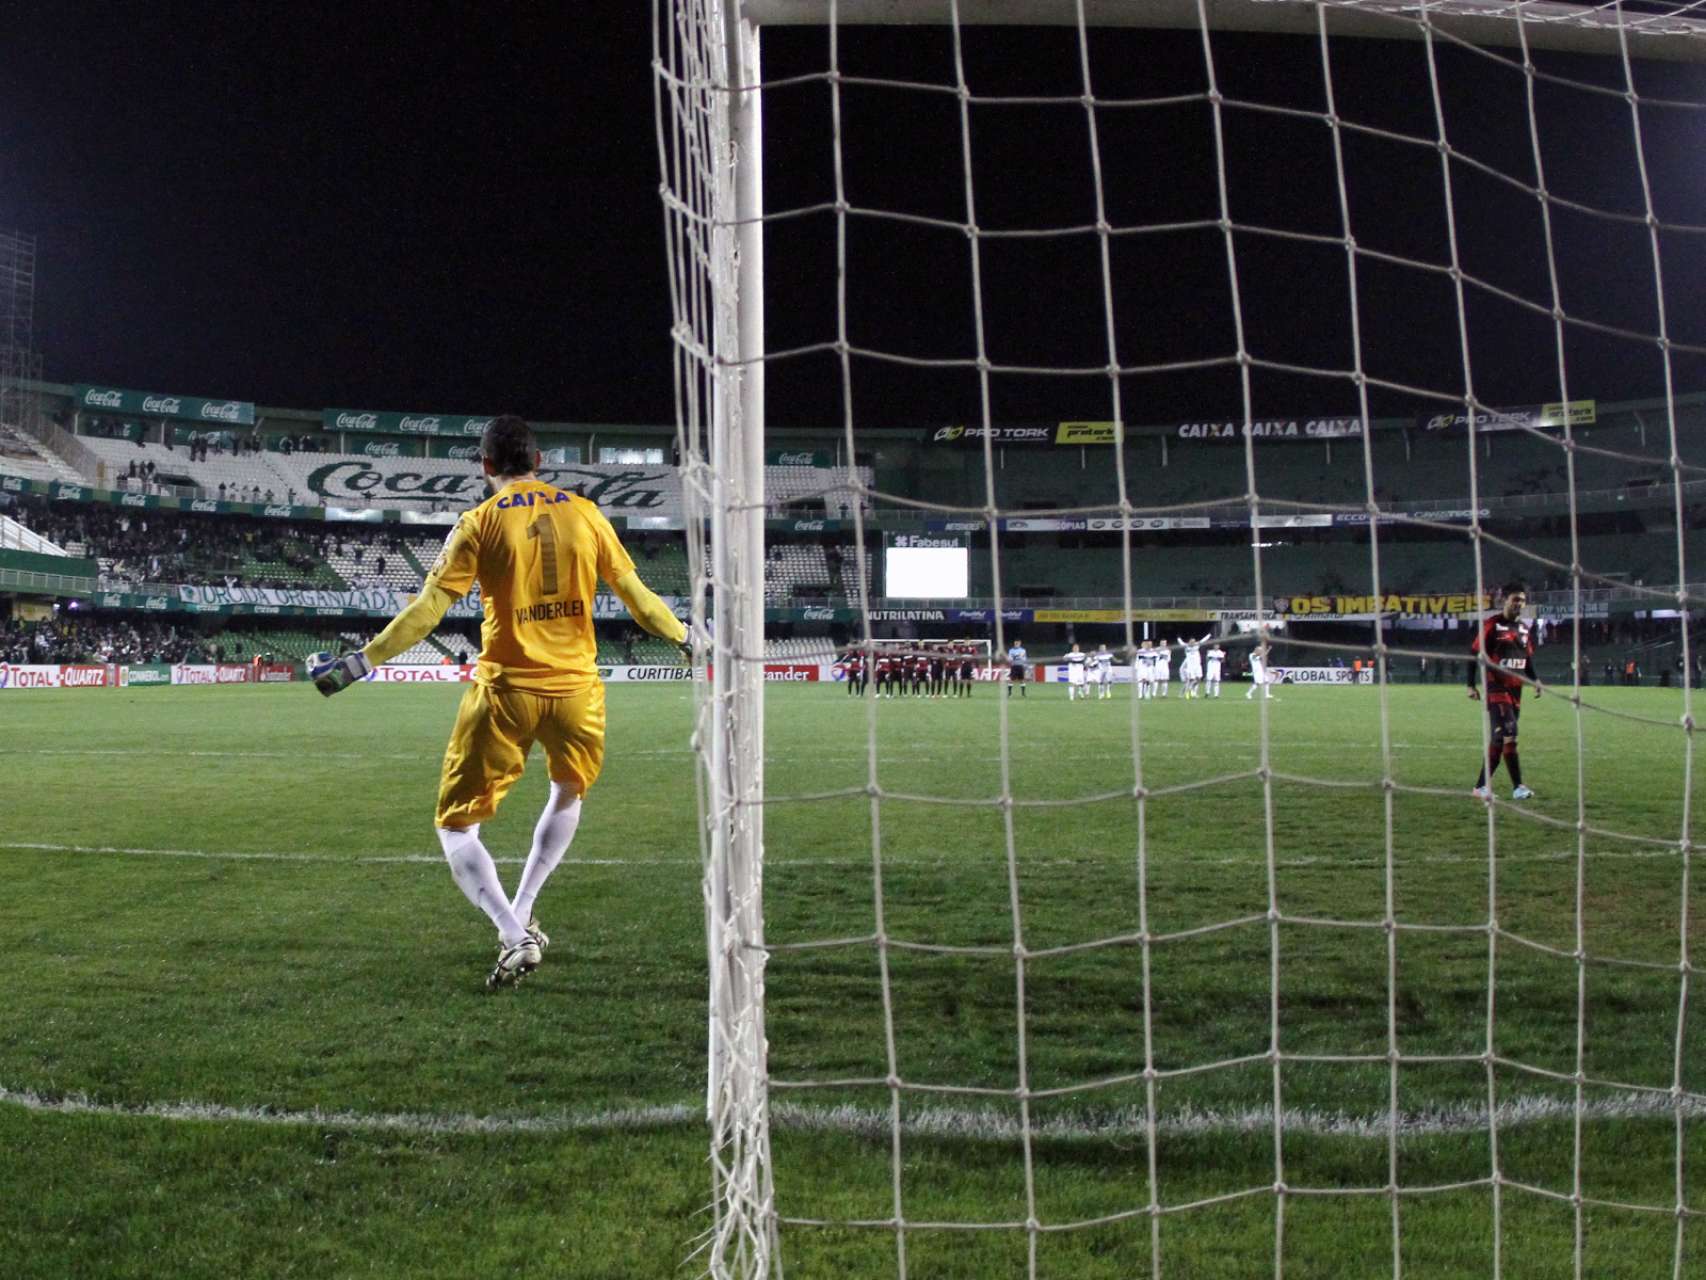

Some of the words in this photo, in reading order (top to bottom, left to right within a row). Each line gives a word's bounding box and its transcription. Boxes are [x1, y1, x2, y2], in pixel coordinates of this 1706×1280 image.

[1003, 428, 1049, 437] TORK
[1178, 423, 1235, 438] CAIXA
[1305, 419, 1362, 435] CAIXA
[908, 535, 959, 548] Fabesul
[526, 513, 559, 596] 1
[516, 600, 584, 624] VANDERLEI
[1291, 598, 1331, 613] OS
[867, 610, 945, 621] NUTRILATINA
[10, 667, 54, 687] TOTAL
[64, 667, 104, 687] QUARTZ
[183, 667, 212, 683] TOTAL
[380, 667, 448, 681] TOTAL
[627, 667, 693, 680] CURITIBA
